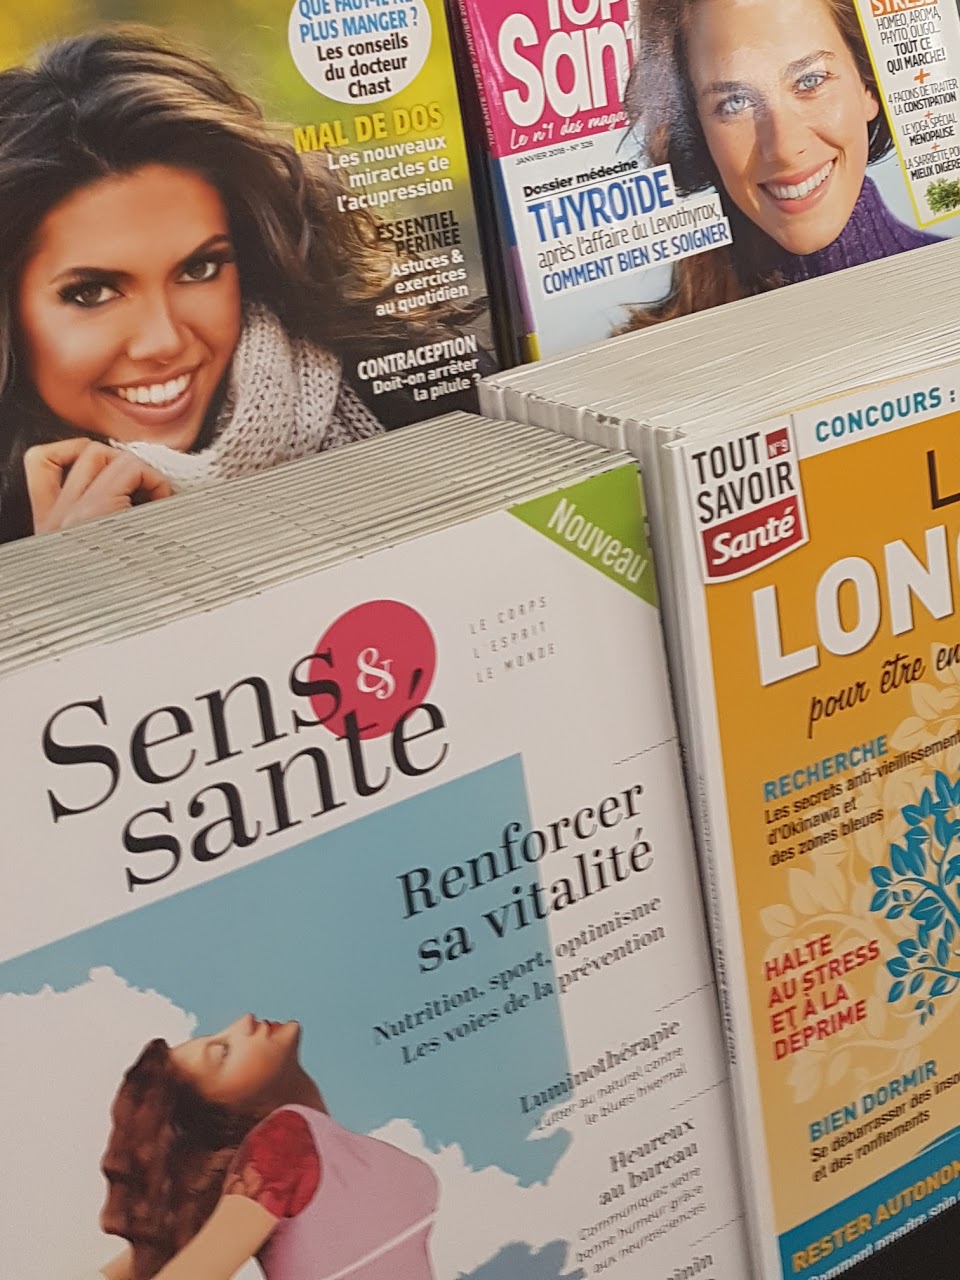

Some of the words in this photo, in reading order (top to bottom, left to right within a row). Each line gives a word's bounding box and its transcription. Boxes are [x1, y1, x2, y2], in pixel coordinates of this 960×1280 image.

[300, 21, 339, 43] PLUS
[343, 11, 407, 37] MANGER
[412, 7, 418, 26] ?
[294, 120, 349, 154] MAL
[355, 112, 388, 143] DE
[394, 102, 443, 136] DOS
[527, 169, 674, 243] THYROÏDE
[543, 257, 613, 295] COMMENT
[619, 245, 650, 272] BIEN
[653, 241, 670, 261] SE
[673, 223, 729, 256] SOIGNER
[358, 334, 477, 381] CONTRACEPTION
[815, 386, 942, 443] CONCOURS
[691, 431, 760, 485] TOUT
[697, 461, 795, 525] SAVOIR
[547, 498, 647, 584] Nouveau
[712, 505, 796, 566] Santé
[41, 646, 342, 824] Sens
[356, 647, 396, 699] &
[763, 734, 889, 802] RECHERCHE
[121, 668, 451, 892] santé
[396, 784, 644, 920] Renforcer
[417, 925, 476, 974] sa
[482, 827, 654, 938] vitalité
[764, 934, 833, 982] HALTE
[774, 999, 868, 1061] DEPRIME
[809, 1102, 857, 1143] BIEN
[862, 1060, 937, 1114] DORMIR
